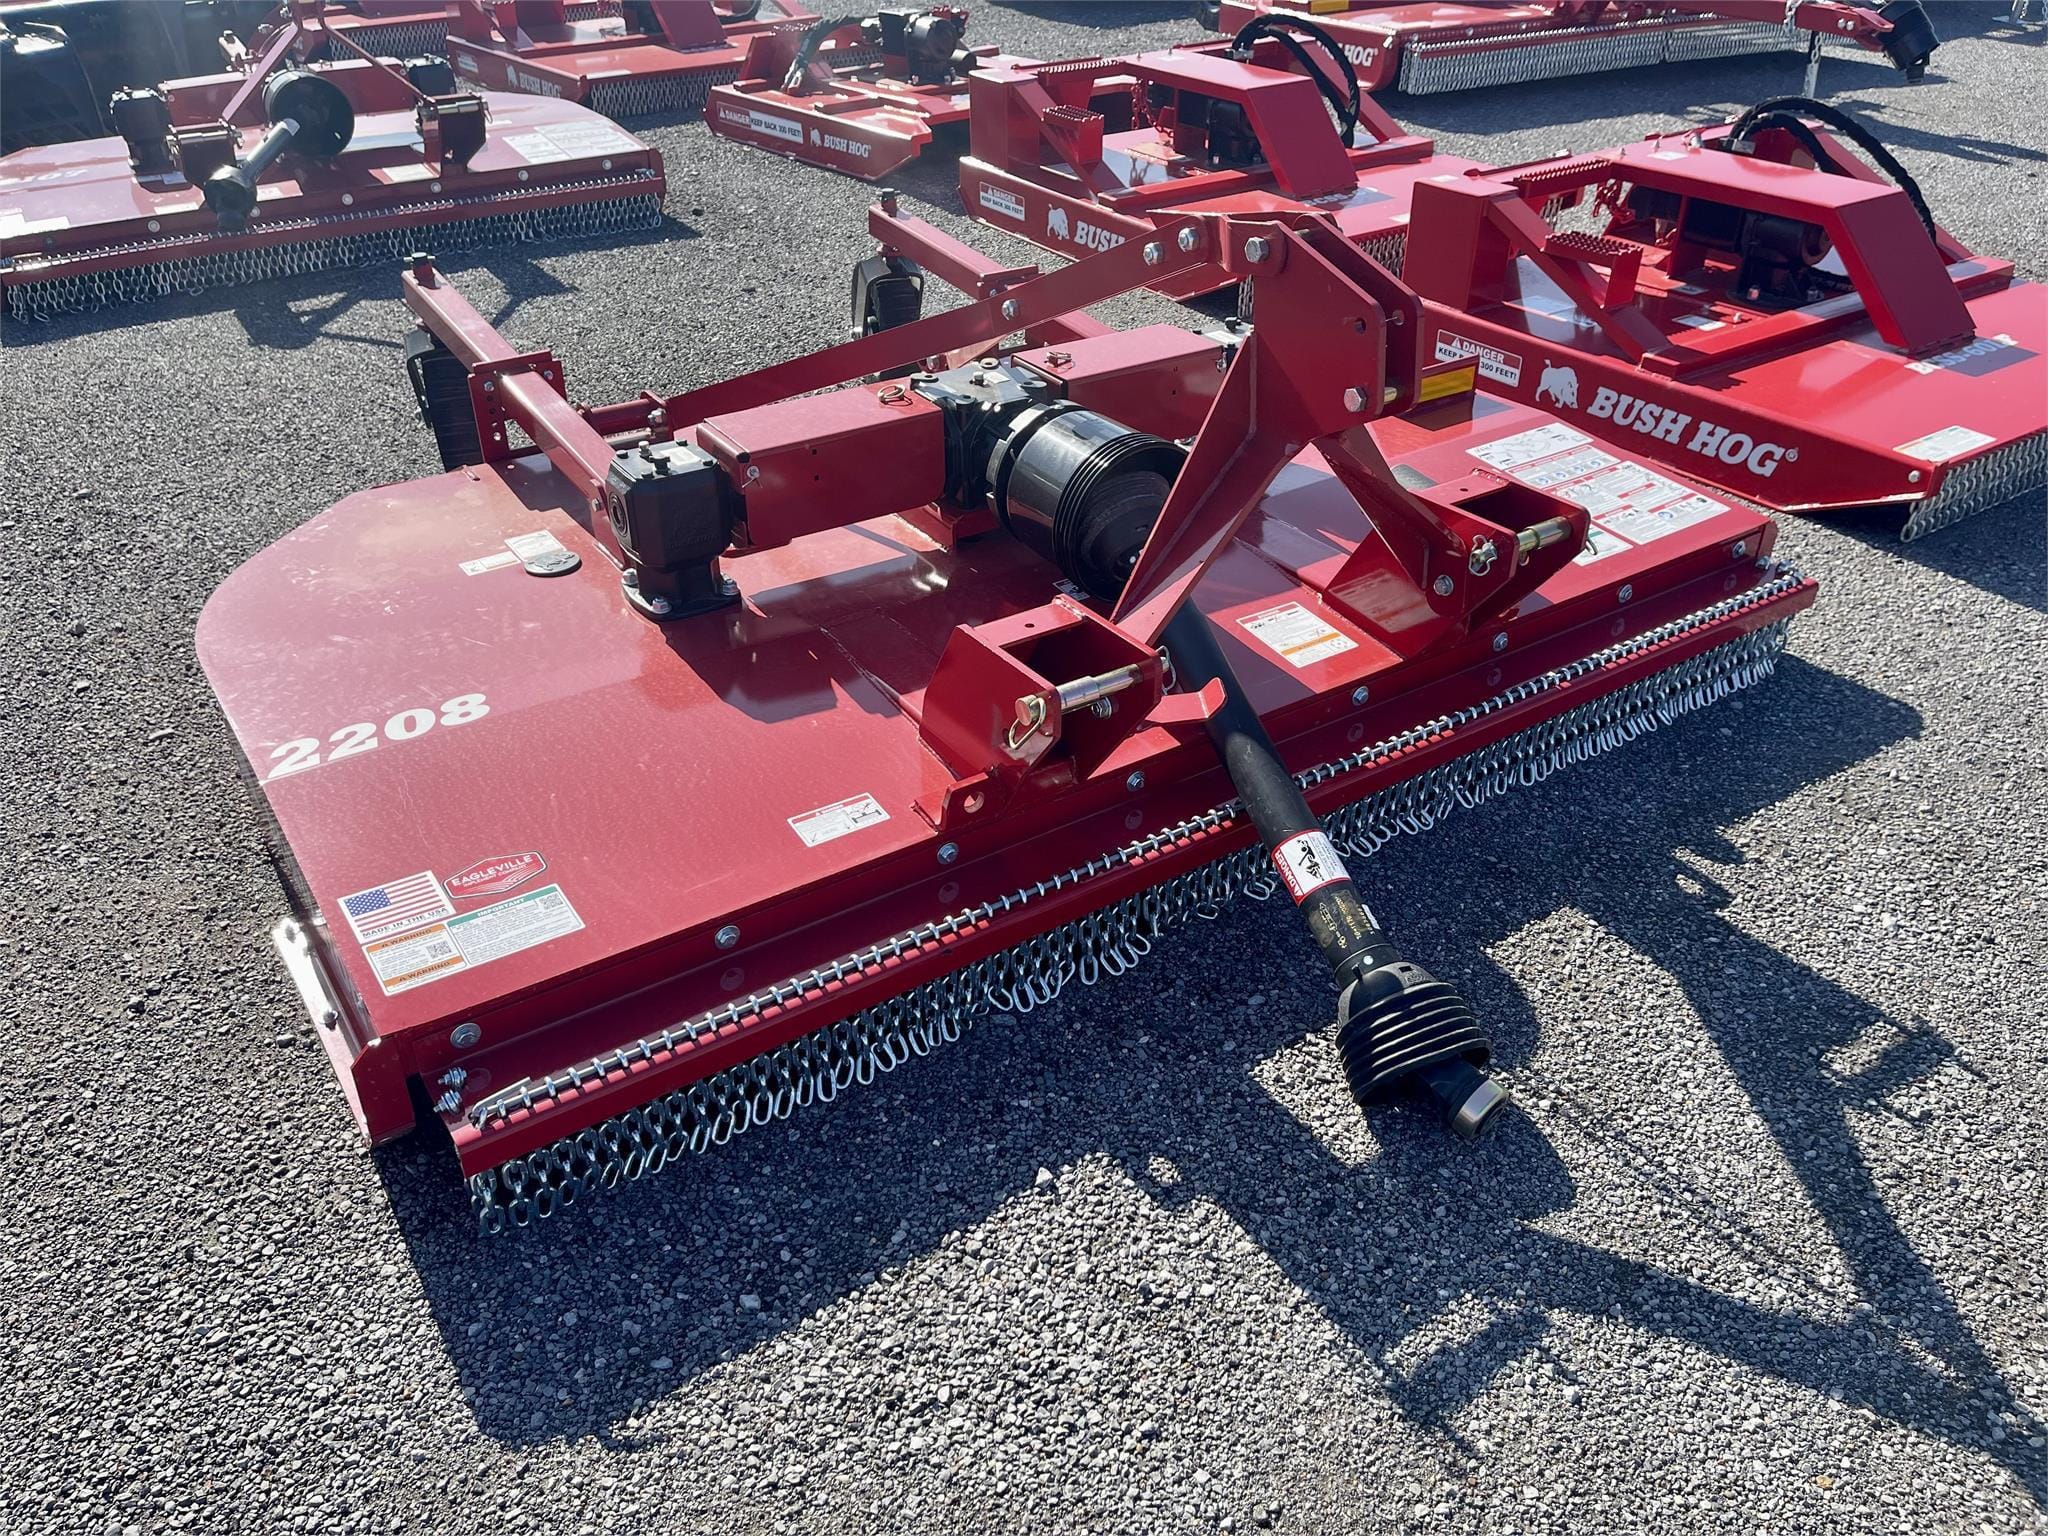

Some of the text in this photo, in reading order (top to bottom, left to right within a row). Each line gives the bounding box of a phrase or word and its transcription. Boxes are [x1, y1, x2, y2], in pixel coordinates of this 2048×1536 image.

[823, 134, 847, 153] BUSH
[1438, 346, 1458, 358] KEEP
[1463, 342, 1505, 363] DANGER
[1480, 361, 1494, 372] 300
[1586, 386, 1693, 445] BUSH
[267, 693, 491, 779] 2208
[451, 855, 533, 887] EAGLEVILLE
[1274, 849, 1298, 889] DANGER
[477, 898, 526, 917] IMPORTANT
[362, 926, 390, 937] MADE
[405, 915, 426, 924] THE
[427, 907, 448, 917] USA
[390, 929, 432, 945] WARNING
[407, 961, 451, 979] WARNING
